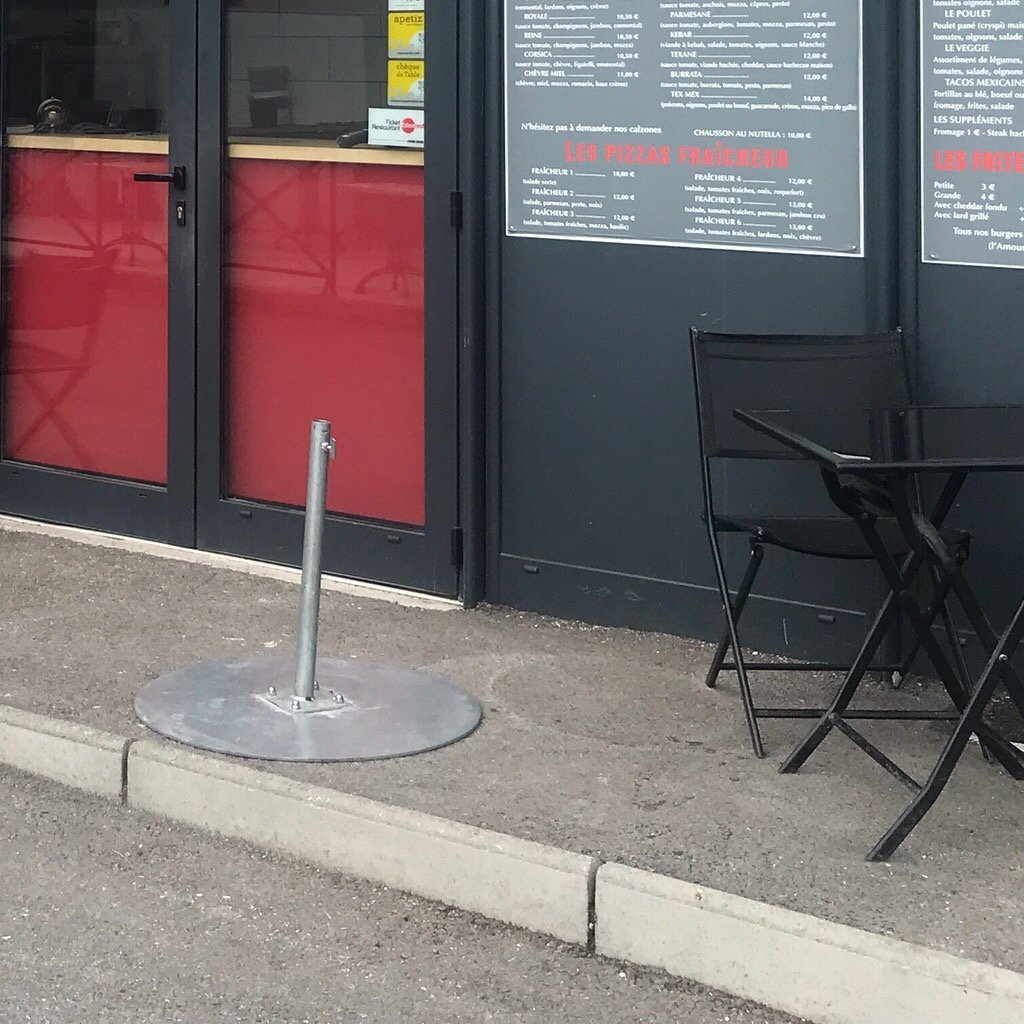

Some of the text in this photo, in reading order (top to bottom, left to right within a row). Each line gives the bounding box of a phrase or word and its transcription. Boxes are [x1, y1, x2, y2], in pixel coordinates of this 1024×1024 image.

[956, 10, 992, 18] POULET
[394, 14, 423, 25] apetiz
[958, 22, 975, 31] pané
[955, 44, 989, 52] VEGGIE
[396, 63, 420, 72] chèque
[977, 79, 1024, 87] MEXICAINS
[950, 114, 1013, 125] SUPPLÉMENTS
[521, 123, 553, 131] N'hésitez
[576, 124, 612, 132] demander
[629, 125, 661, 134] calzones
[748, 130, 780, 138] NUTELLA
[564, 139, 789, 169] LES PIZZAS FRAÎCHEUR
[933, 150, 1024, 173] LES FRITE
[532, 167, 568, 175] FRAÎCHEUR
[695, 173, 735, 182] FRAÎCHEUR
[934, 192, 961, 200] Grande
[953, 203, 983, 212] cheddar
[986, 203, 1007, 212] fondu
[953, 212, 968, 220] lard
[970, 213, 989, 221] grillé
[953, 227, 1023, 239] Tous nos burgers
